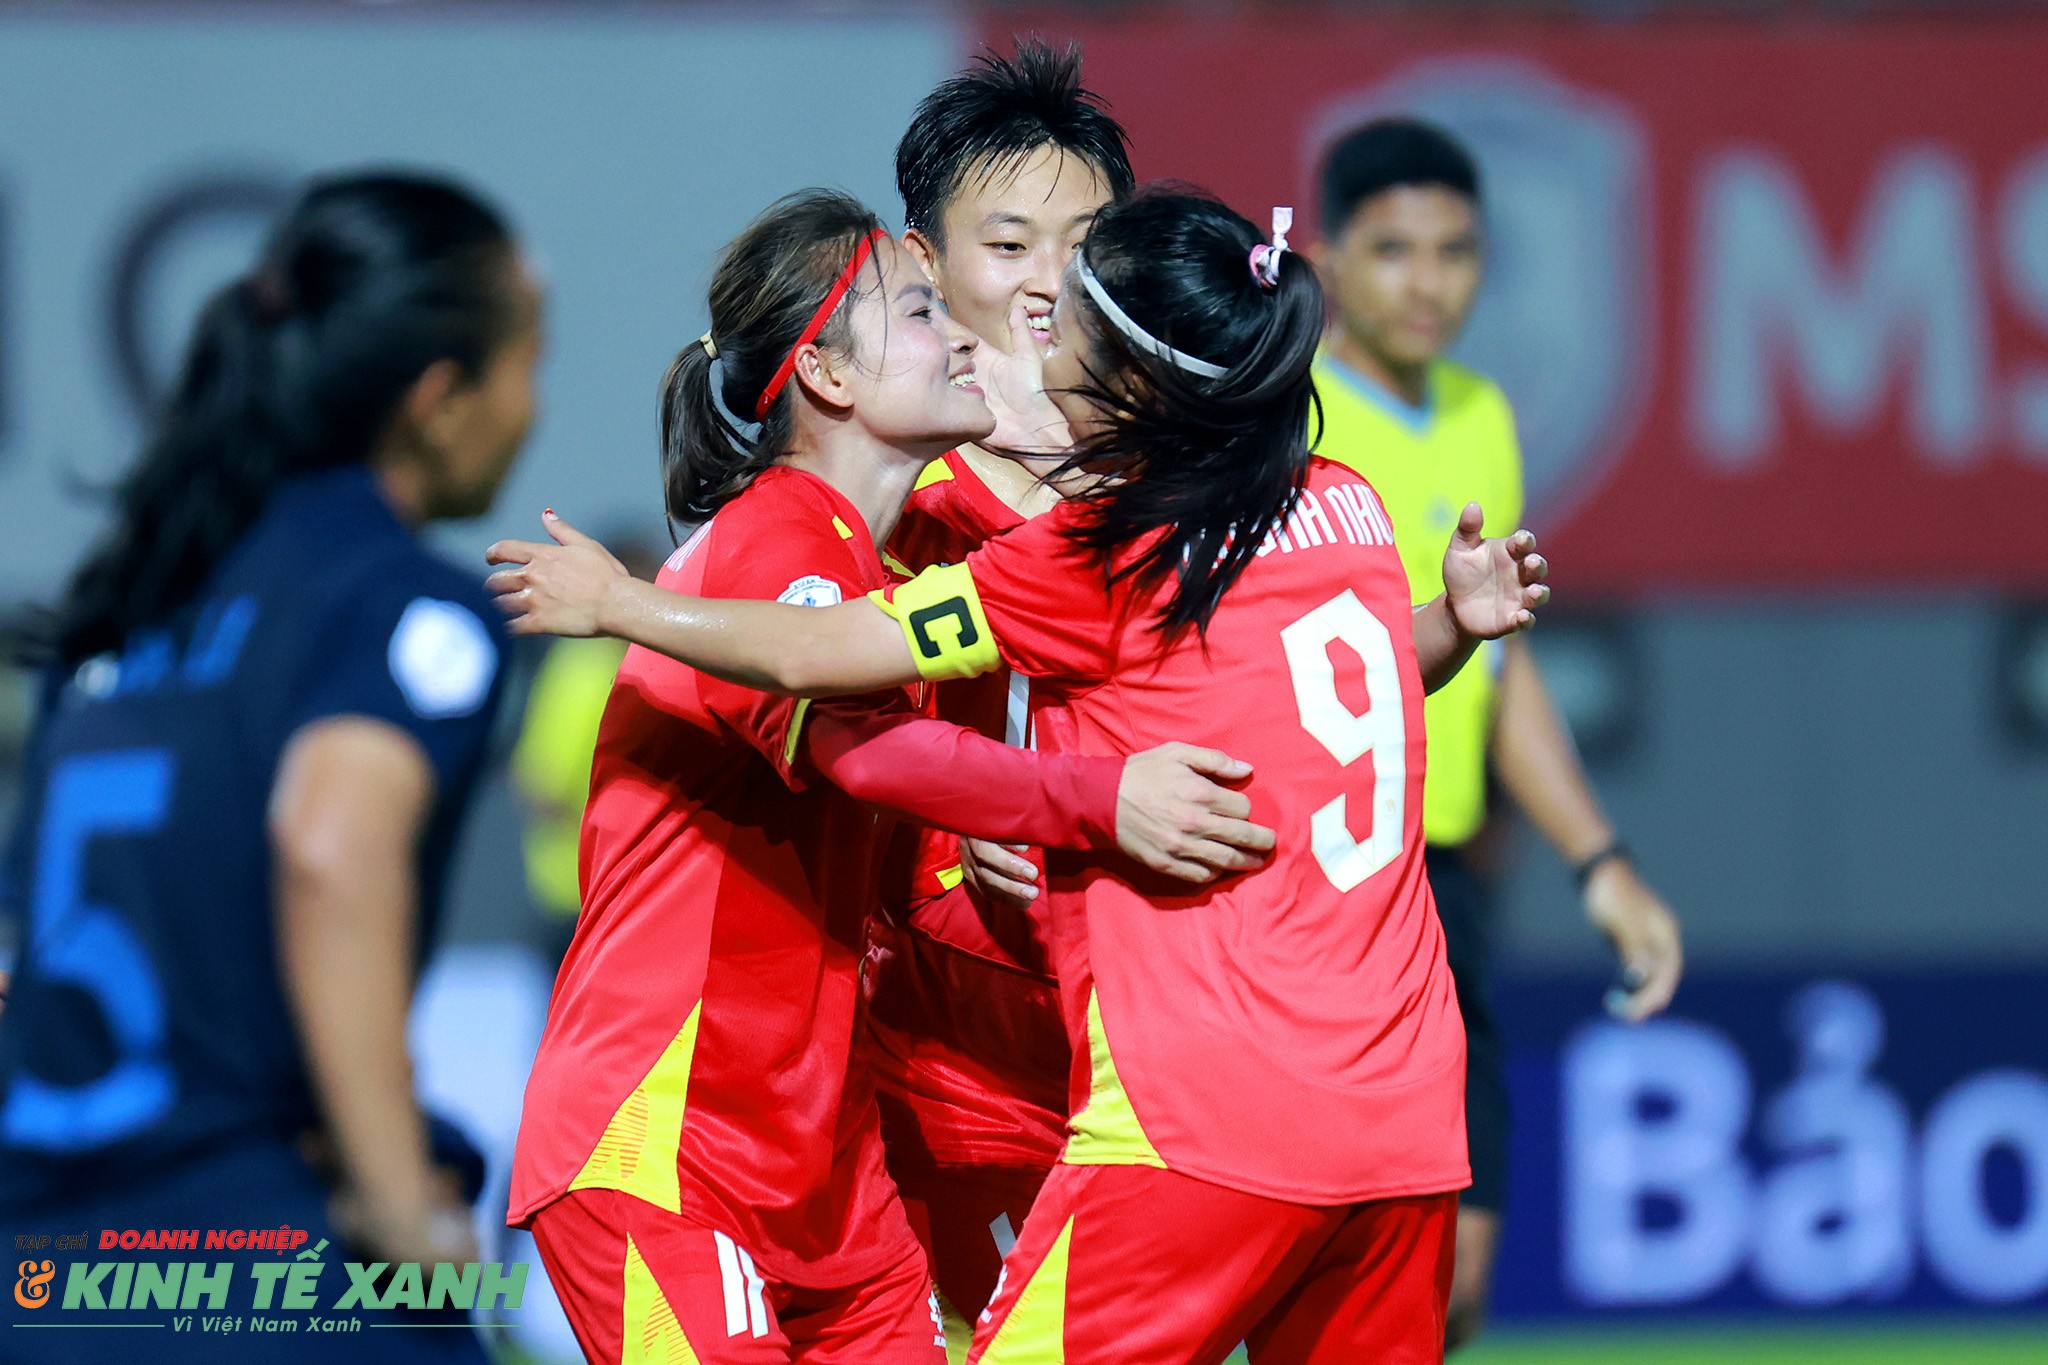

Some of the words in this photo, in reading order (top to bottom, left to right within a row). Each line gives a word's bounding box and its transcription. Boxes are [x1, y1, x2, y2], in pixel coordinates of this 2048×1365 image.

[1692, 145, 2048, 470] M
[908, 595, 979, 659] C
[1279, 587, 1406, 894] 9
[2, 746, 176, 1151] 5
